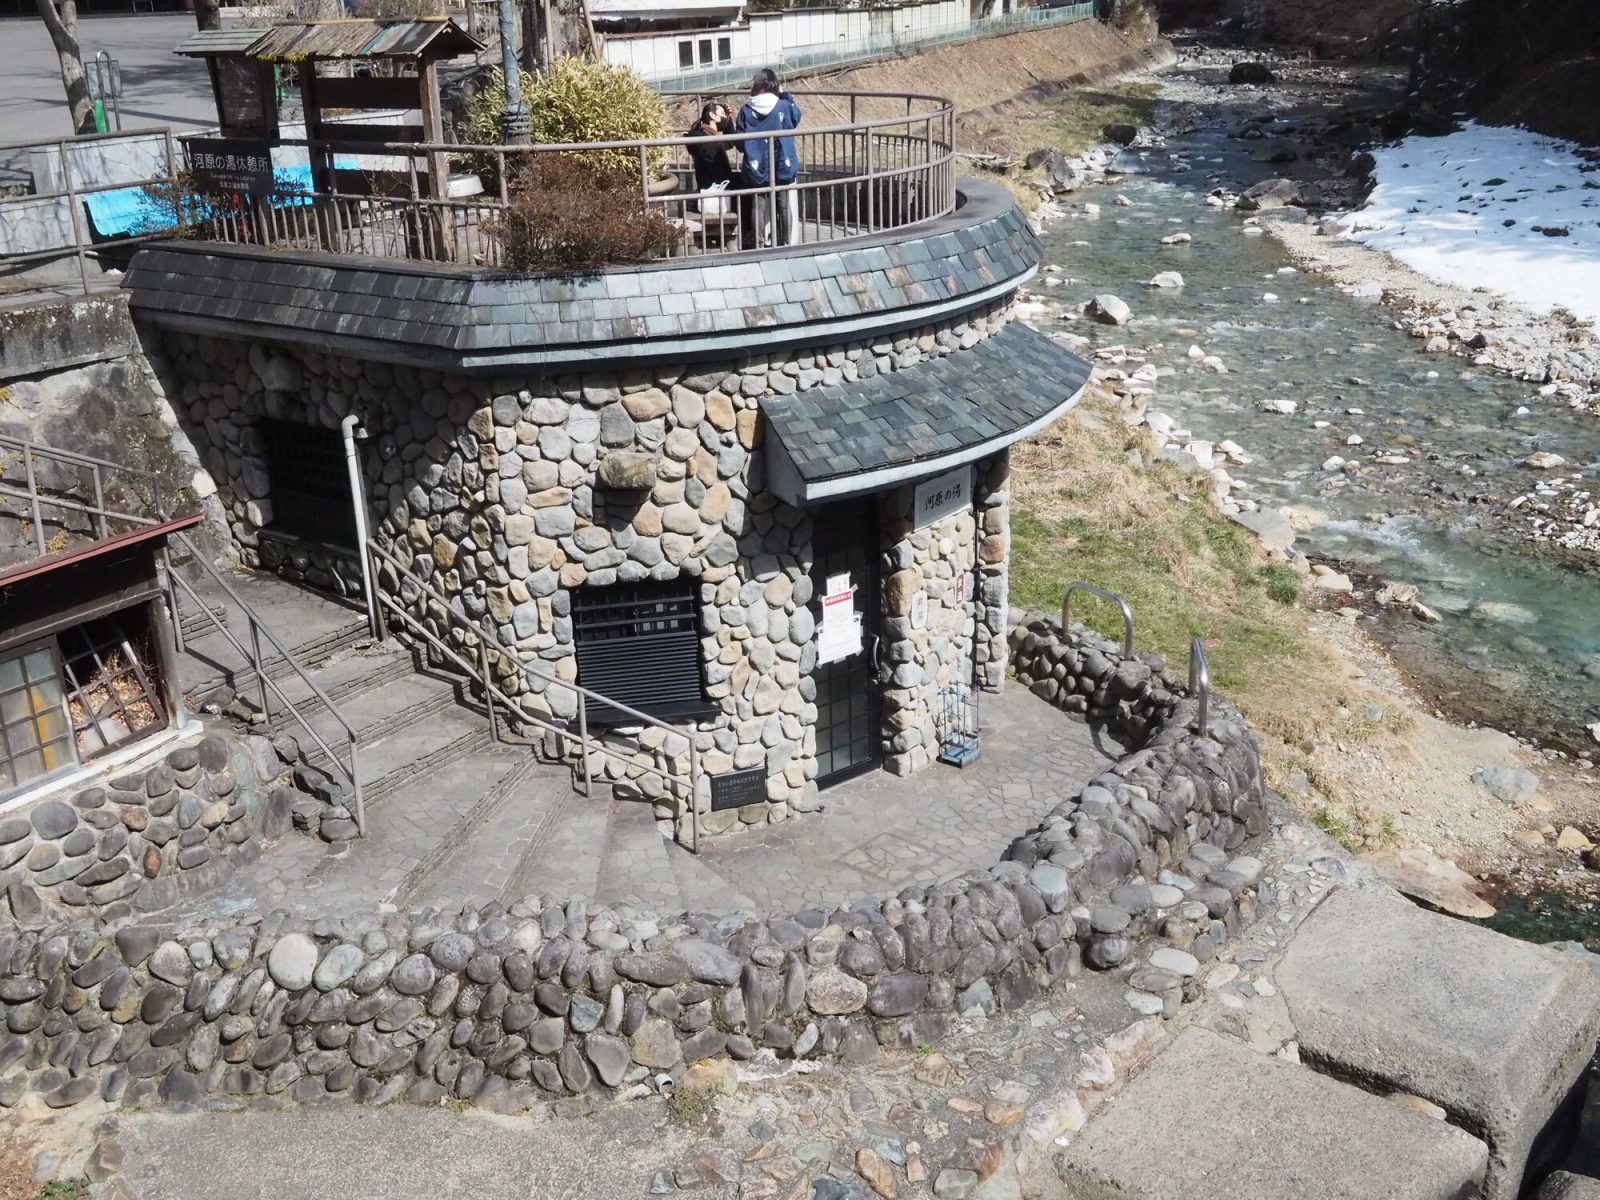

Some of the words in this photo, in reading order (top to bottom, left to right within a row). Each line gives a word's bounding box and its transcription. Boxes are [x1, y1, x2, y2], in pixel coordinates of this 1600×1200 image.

[194, 153, 269, 173] 河原の湯休憩所
[925, 482, 961, 511] 河原の湯
